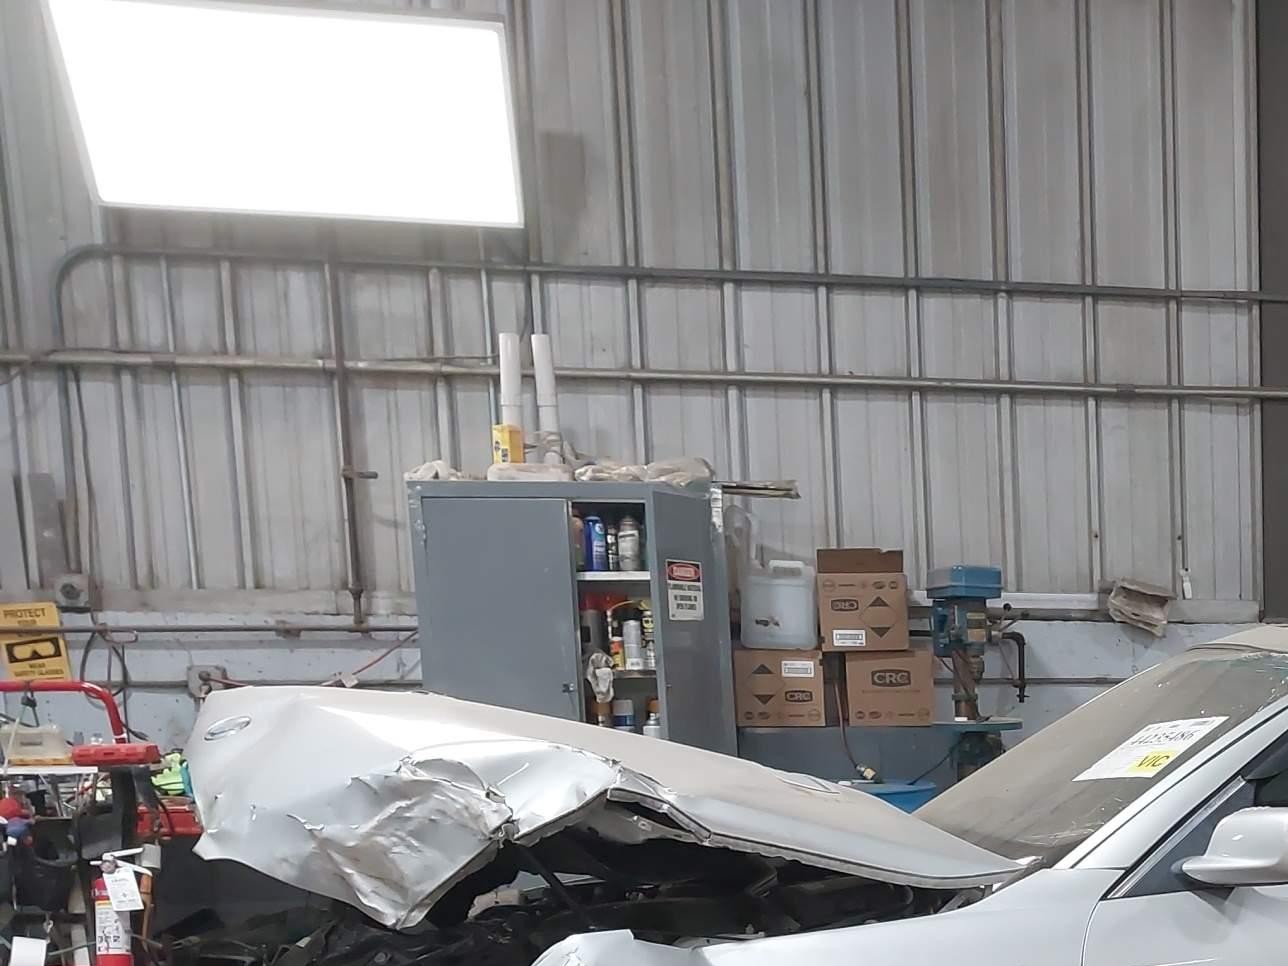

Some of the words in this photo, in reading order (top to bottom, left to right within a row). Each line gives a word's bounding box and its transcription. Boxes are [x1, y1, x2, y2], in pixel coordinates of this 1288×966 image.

[874, 672, 908, 684] CRC
[786, 692, 811, 701] CRC
[1136, 755, 1170, 768] VIC
